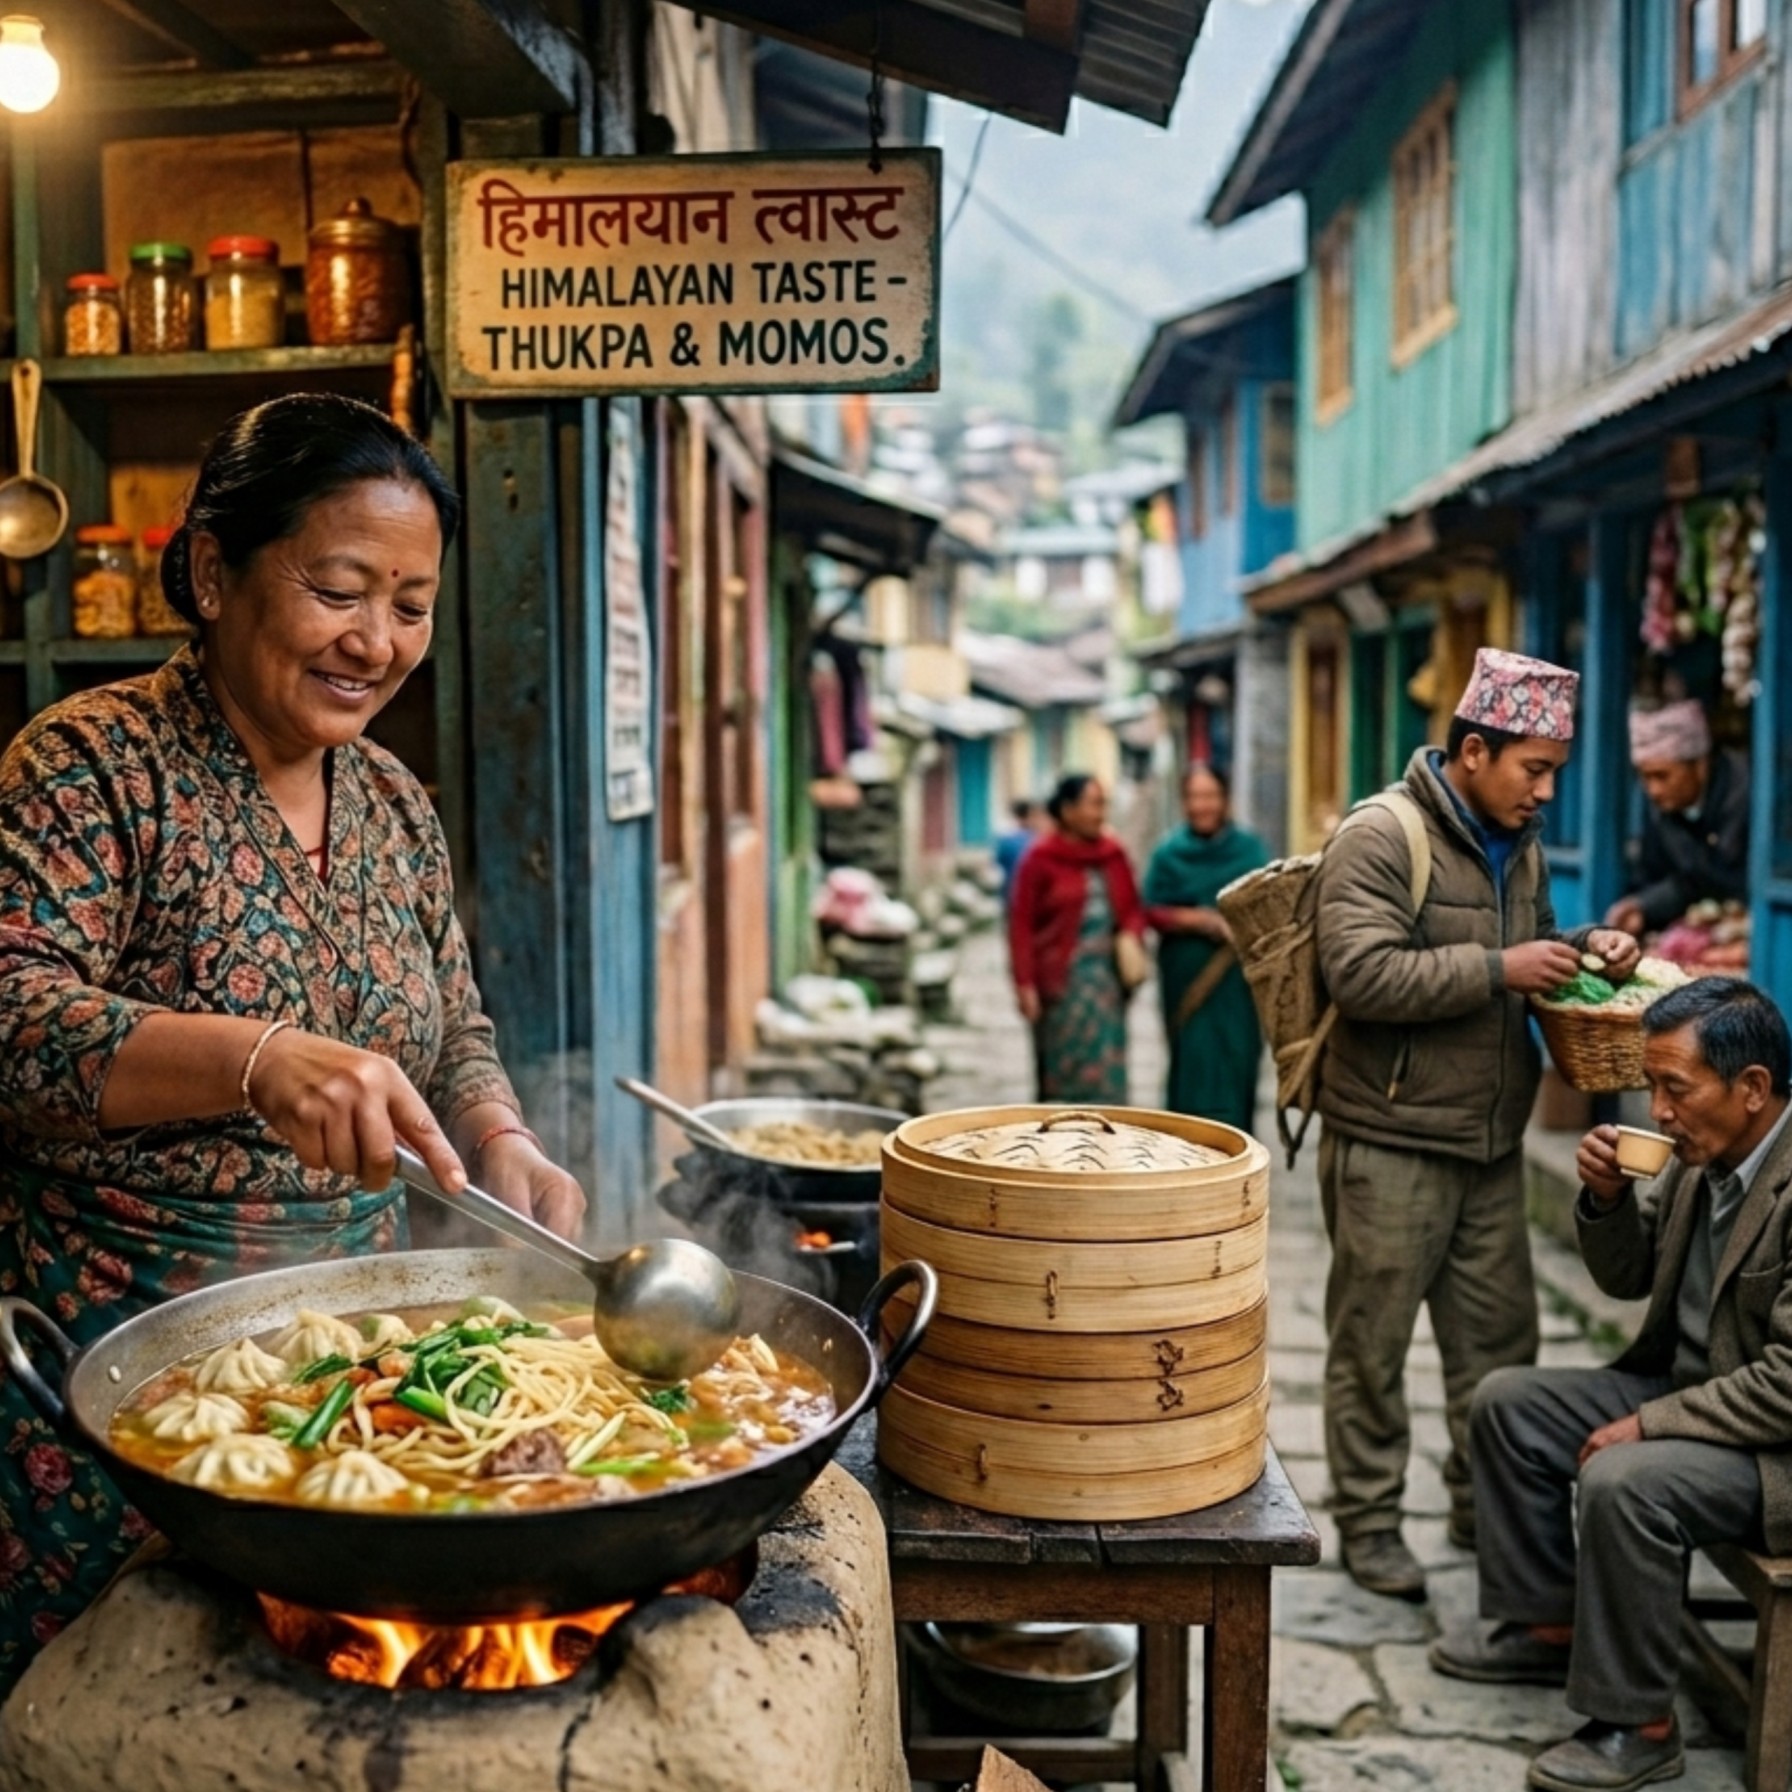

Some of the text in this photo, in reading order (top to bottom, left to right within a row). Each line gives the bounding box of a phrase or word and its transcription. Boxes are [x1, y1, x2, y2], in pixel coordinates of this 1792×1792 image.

[477, 178, 905, 257] हिमालयान त्वास्ट
[502, 262, 734, 309] HIMALAYAN
[751, 260, 877, 303] TASTE
[481, 318, 906, 371] THUKPA & MOMOS.
